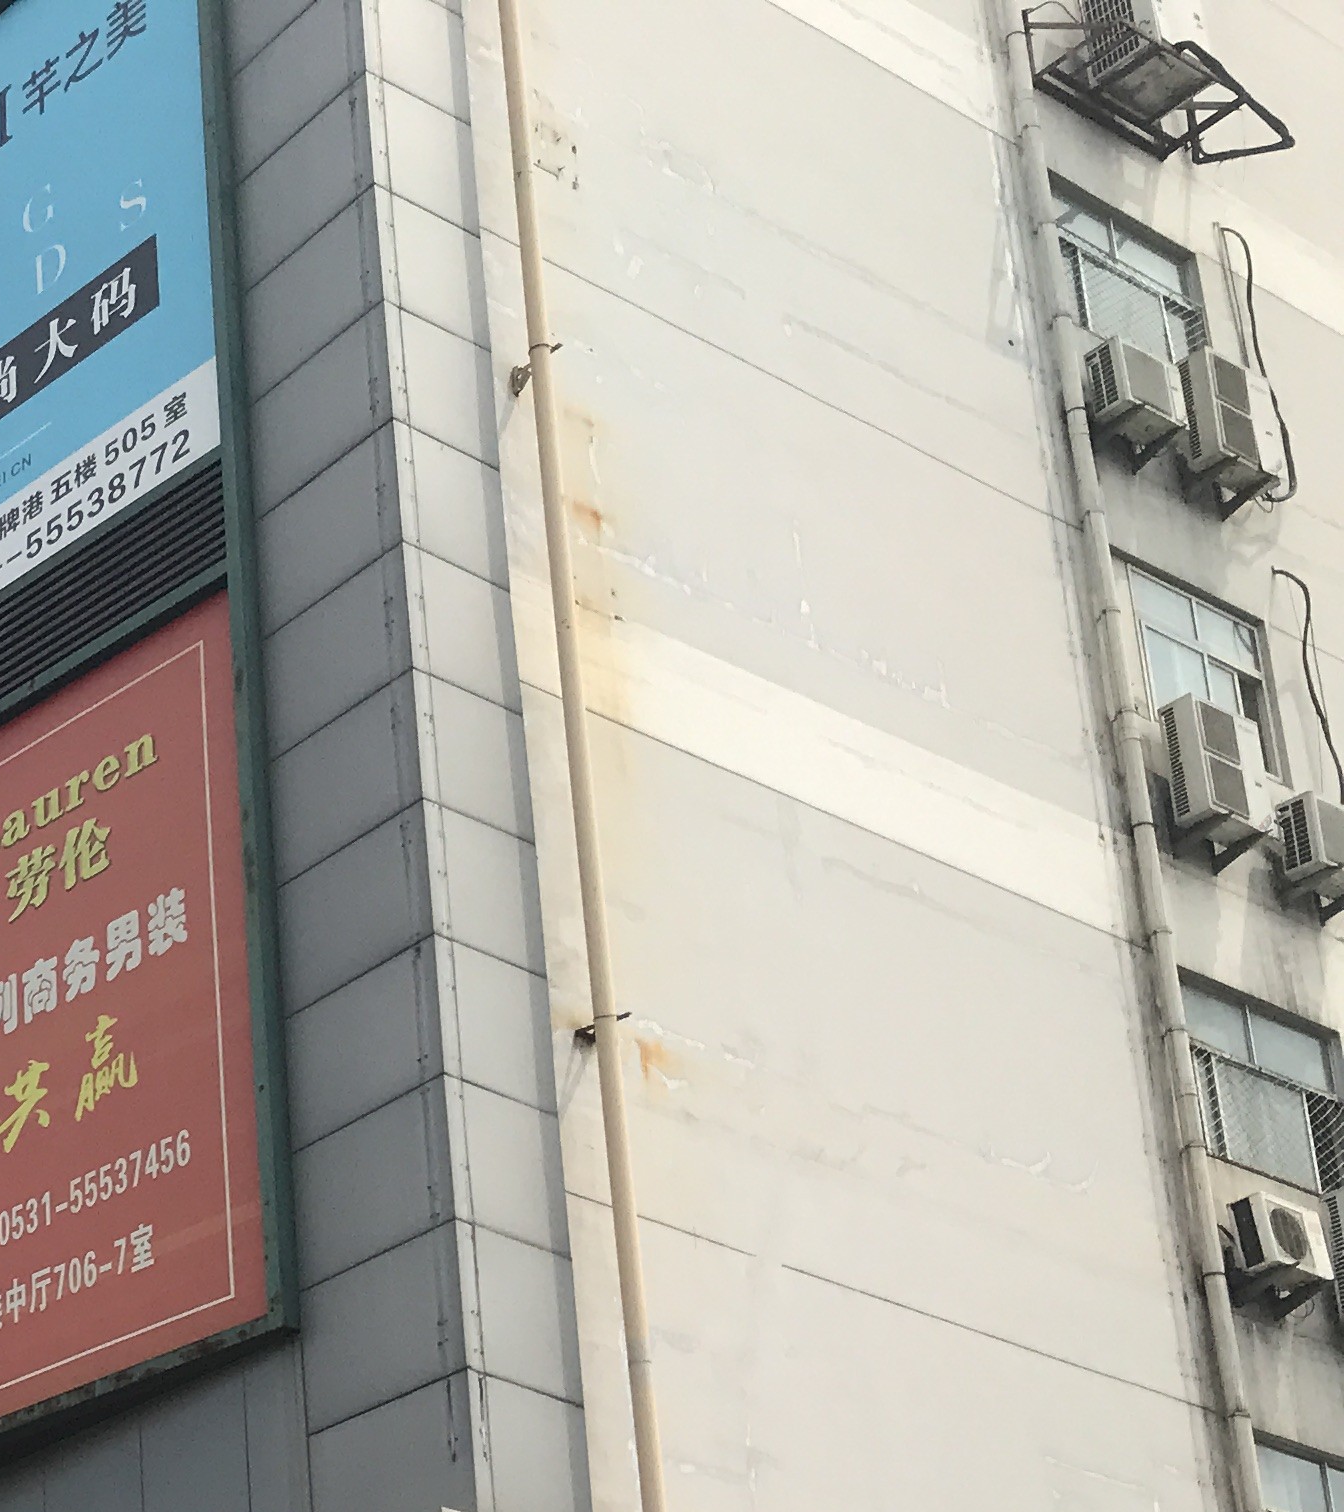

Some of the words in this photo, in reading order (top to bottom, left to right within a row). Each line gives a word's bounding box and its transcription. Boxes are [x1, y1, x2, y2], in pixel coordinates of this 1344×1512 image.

[50, 454, 97, 504] 五楼
[104, 415, 157, 464] 505
[164, 392, 188, 427] 室
